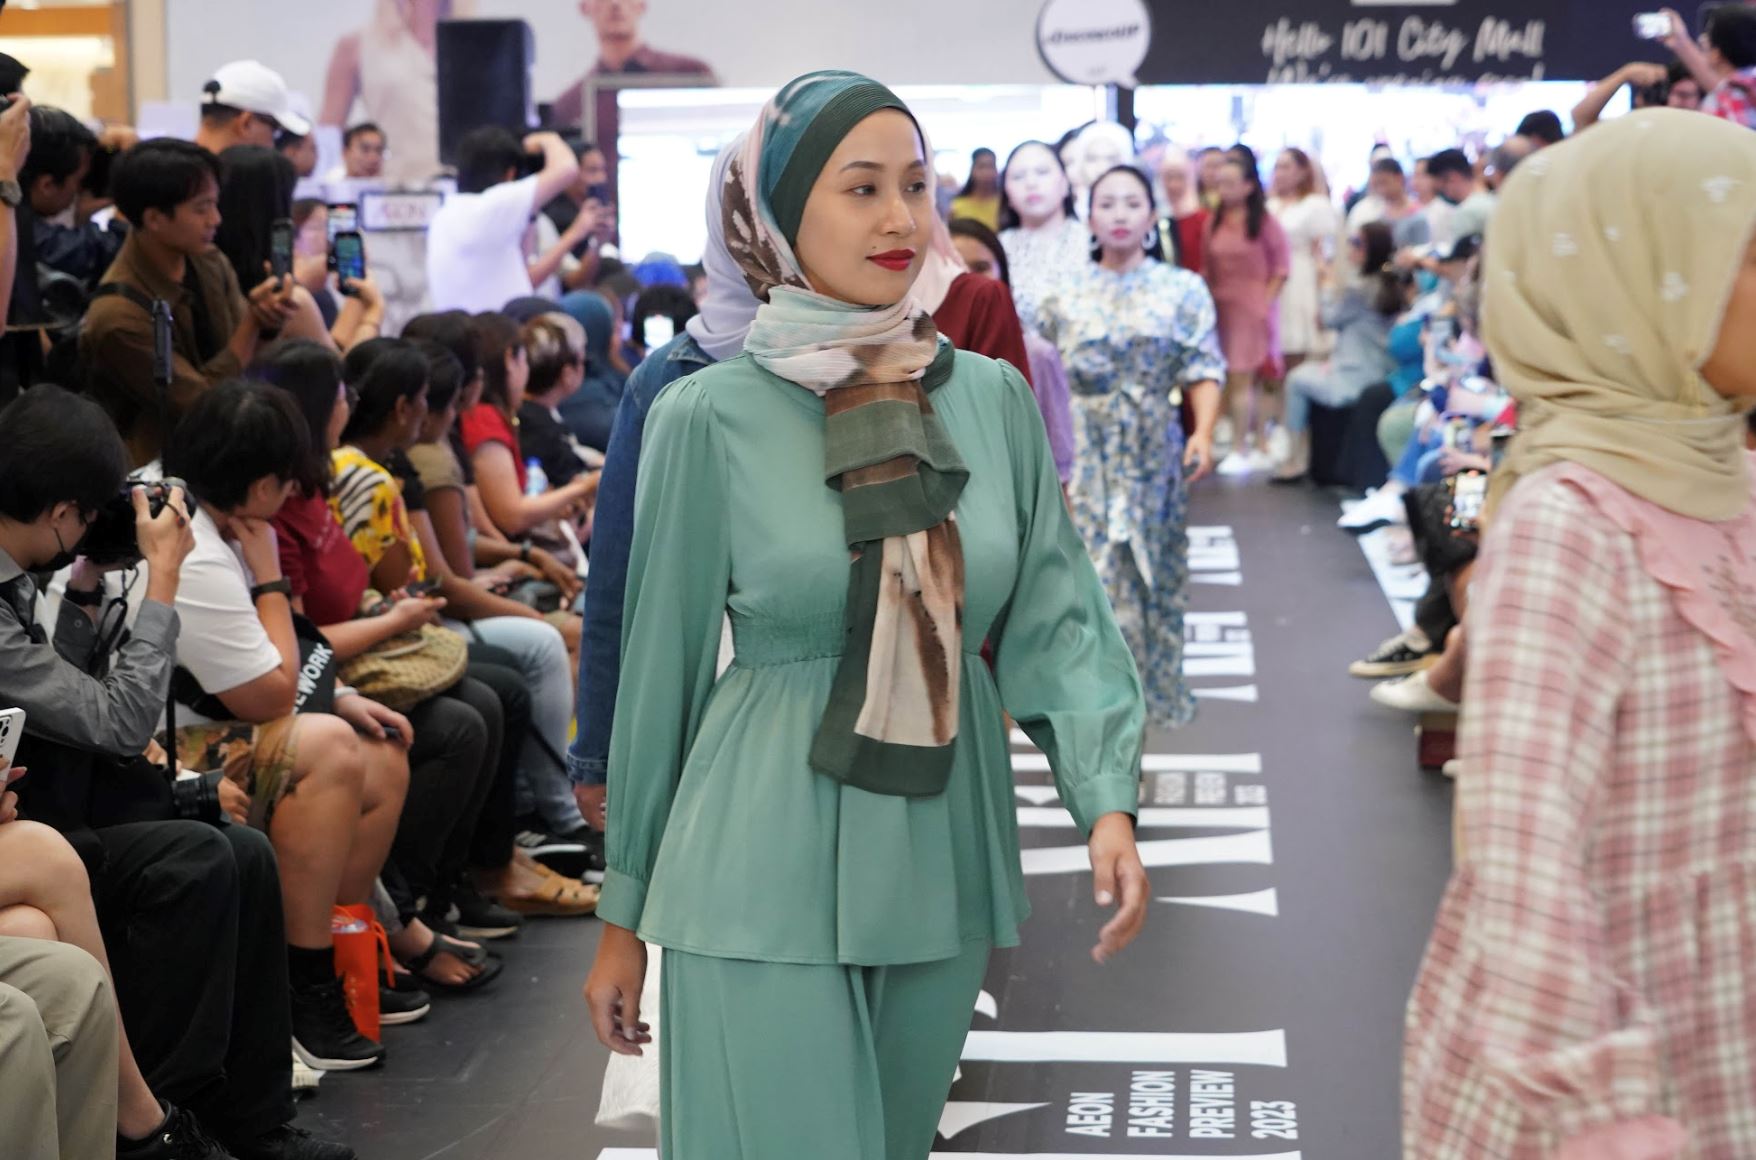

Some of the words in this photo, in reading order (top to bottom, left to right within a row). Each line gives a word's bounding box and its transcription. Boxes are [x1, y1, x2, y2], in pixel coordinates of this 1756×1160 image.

[1261, 16, 1333, 66] Hello
[1341, 18, 1389, 60] 101
[1397, 15, 1469, 71] City
[1472, 15, 1546, 62] Mall
[1065, 1092, 1114, 1137] AEON
[1127, 1070, 1175, 1137] FASHION
[1189, 1069, 1235, 1138] PREVIEW
[1250, 1101, 1298, 1139] 2023
